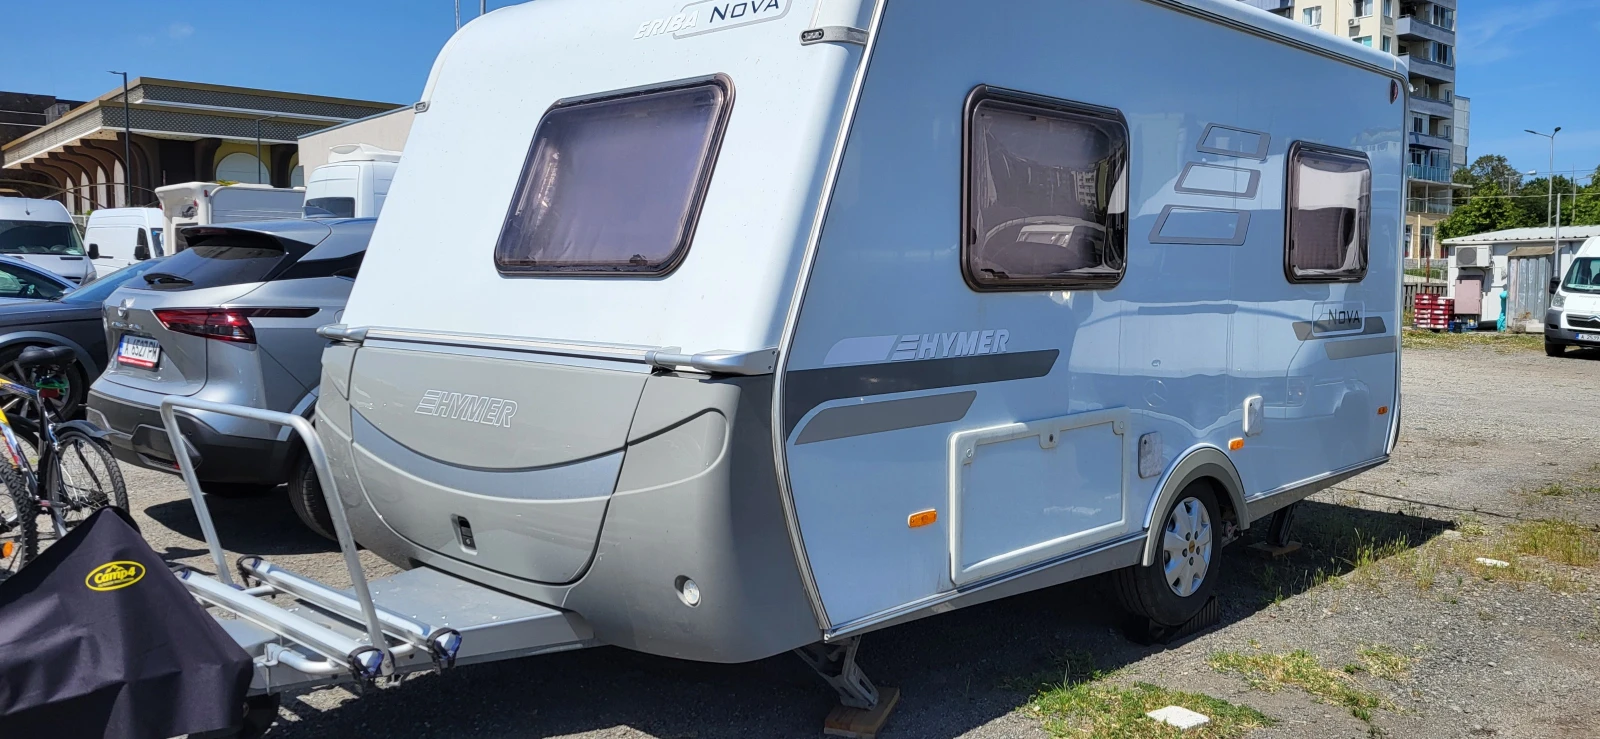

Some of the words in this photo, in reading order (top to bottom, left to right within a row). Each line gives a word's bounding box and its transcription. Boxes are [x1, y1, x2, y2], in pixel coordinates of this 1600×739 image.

[633, 10, 699, 40] ERIBA
[709, 0, 779, 22] NOVA
[1328, 309, 1360, 324] NOVA
[918, 329, 1009, 359] HYMER
[433, 390, 518, 427] HYMER
